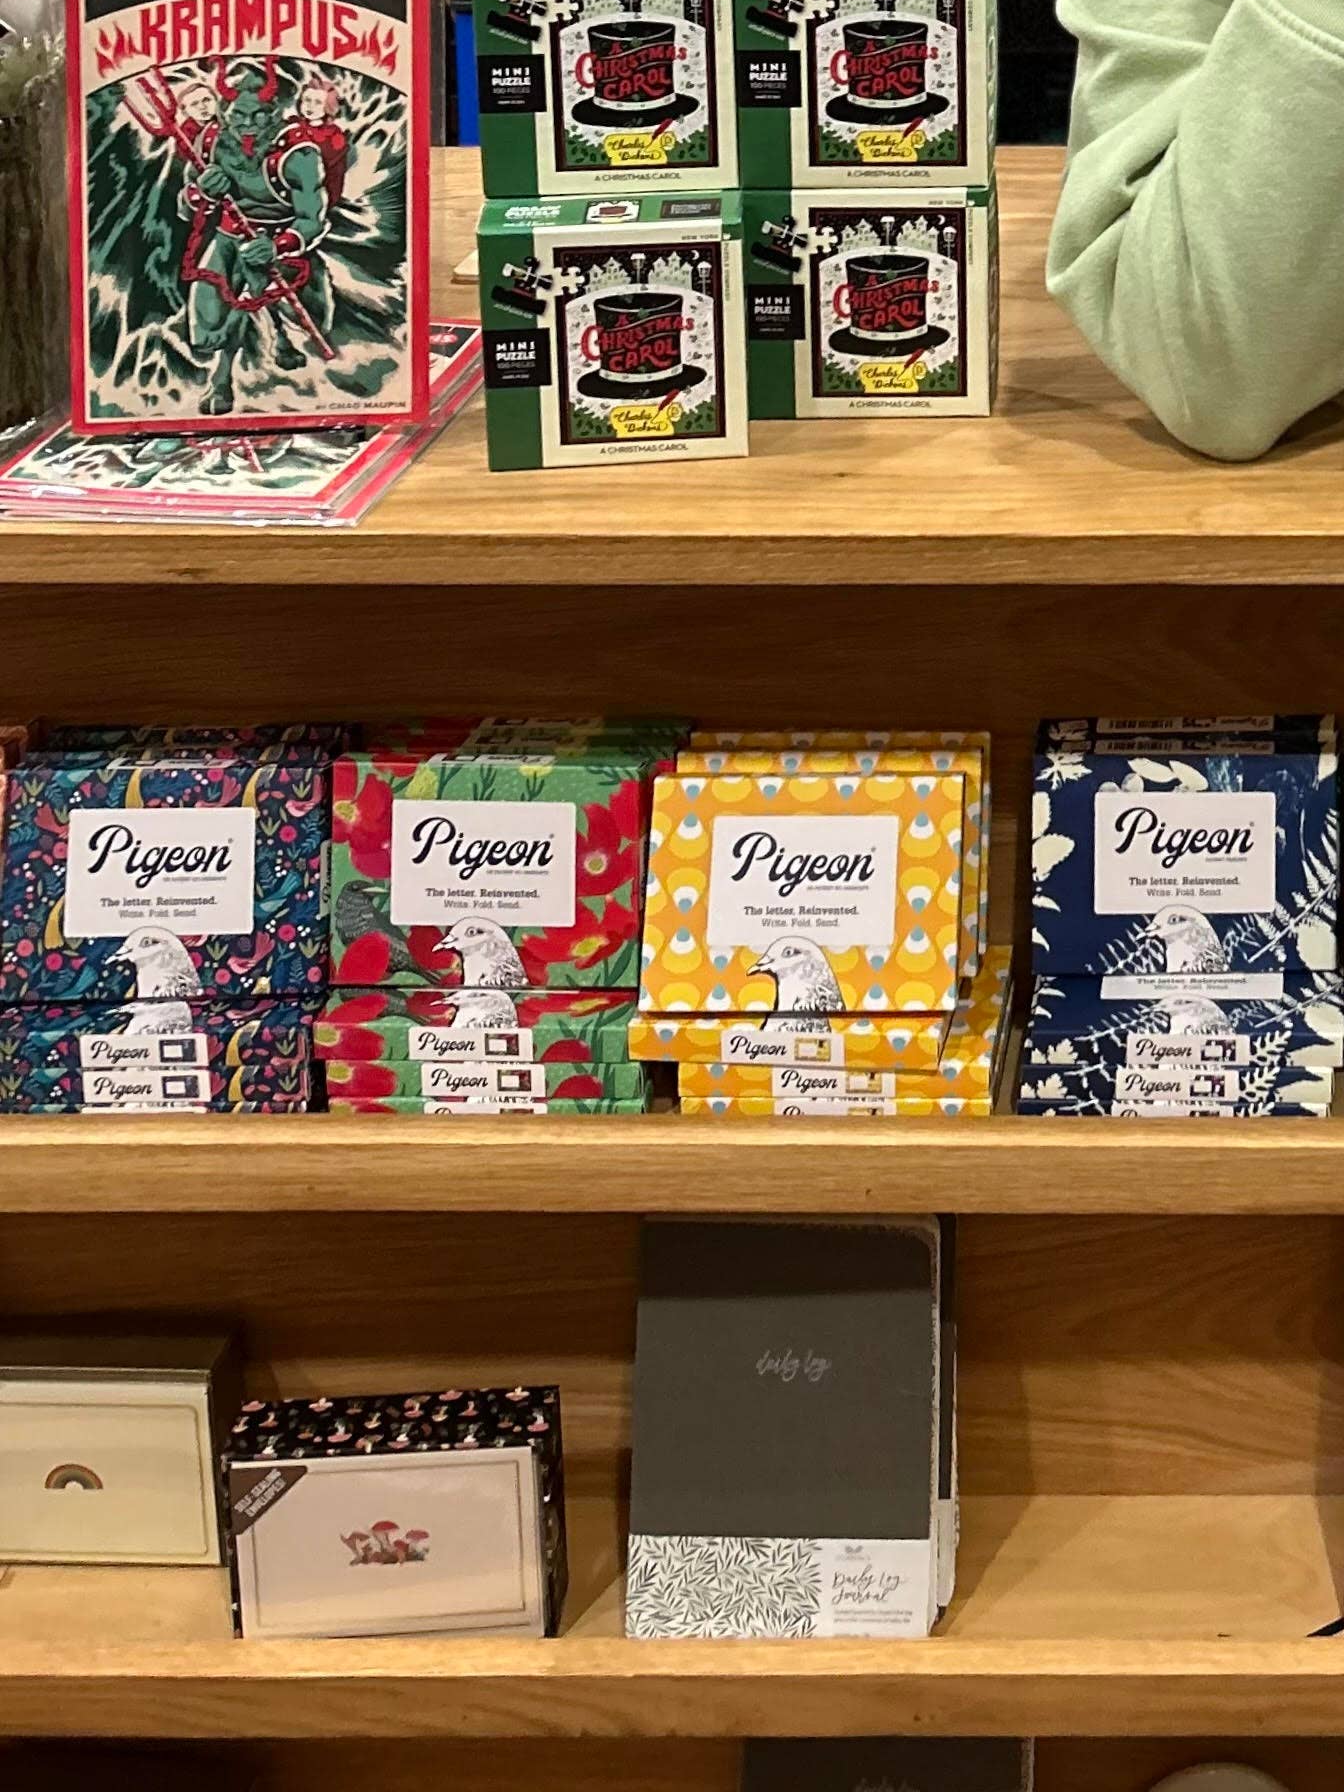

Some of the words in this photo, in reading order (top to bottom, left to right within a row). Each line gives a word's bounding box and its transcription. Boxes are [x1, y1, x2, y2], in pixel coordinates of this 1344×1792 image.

[491, 67, 531, 76] MINI
[750, 63, 787, 71] MINI
[750, 72, 787, 81] PUZZLE
[491, 77, 531, 86] PUZZLE
[603, 66, 674, 99] CAROL
[856, 66, 924, 96] CAROL
[602, 173, 650, 181] CHRISTMAS
[652, 171, 681, 180] CAROL
[854, 170, 900, 178] CHRISTMAS
[754, 305, 791, 314] PUZZLE
[755, 297, 791, 305] MINI
[859, 300, 924, 329] CAROL
[496, 342, 535, 351] MINI
[496, 352, 536, 361] PUZZLE
[608, 339, 678, 371] CAROL
[608, 445, 658, 454] CHRISTMAS
[659, 444, 688, 452] CAROL
[1115, 807, 1254, 868] Pigeon
[88, 824, 232, 888] Pigeon
[412, 817, 553, 880] Pigeon
[732, 832, 874, 897] Pigeon
[1129, 877, 1147, 886] The
[101, 897, 119, 906] The
[426, 888, 444, 897] The
[744, 906, 762, 915] The
[90, 1040, 149, 1062] Pigeon
[418, 1031, 477, 1053] Pigeon
[729, 1035, 788, 1058] Pigeon
[1135, 1038, 1192, 1060] Pigeon
[94, 1075, 152, 1096] Pigeon
[430, 1067, 488, 1090] Pigeon
[780, 1070, 838, 1093] Pigeon
[1123, 1074, 1182, 1096] Pigeon
